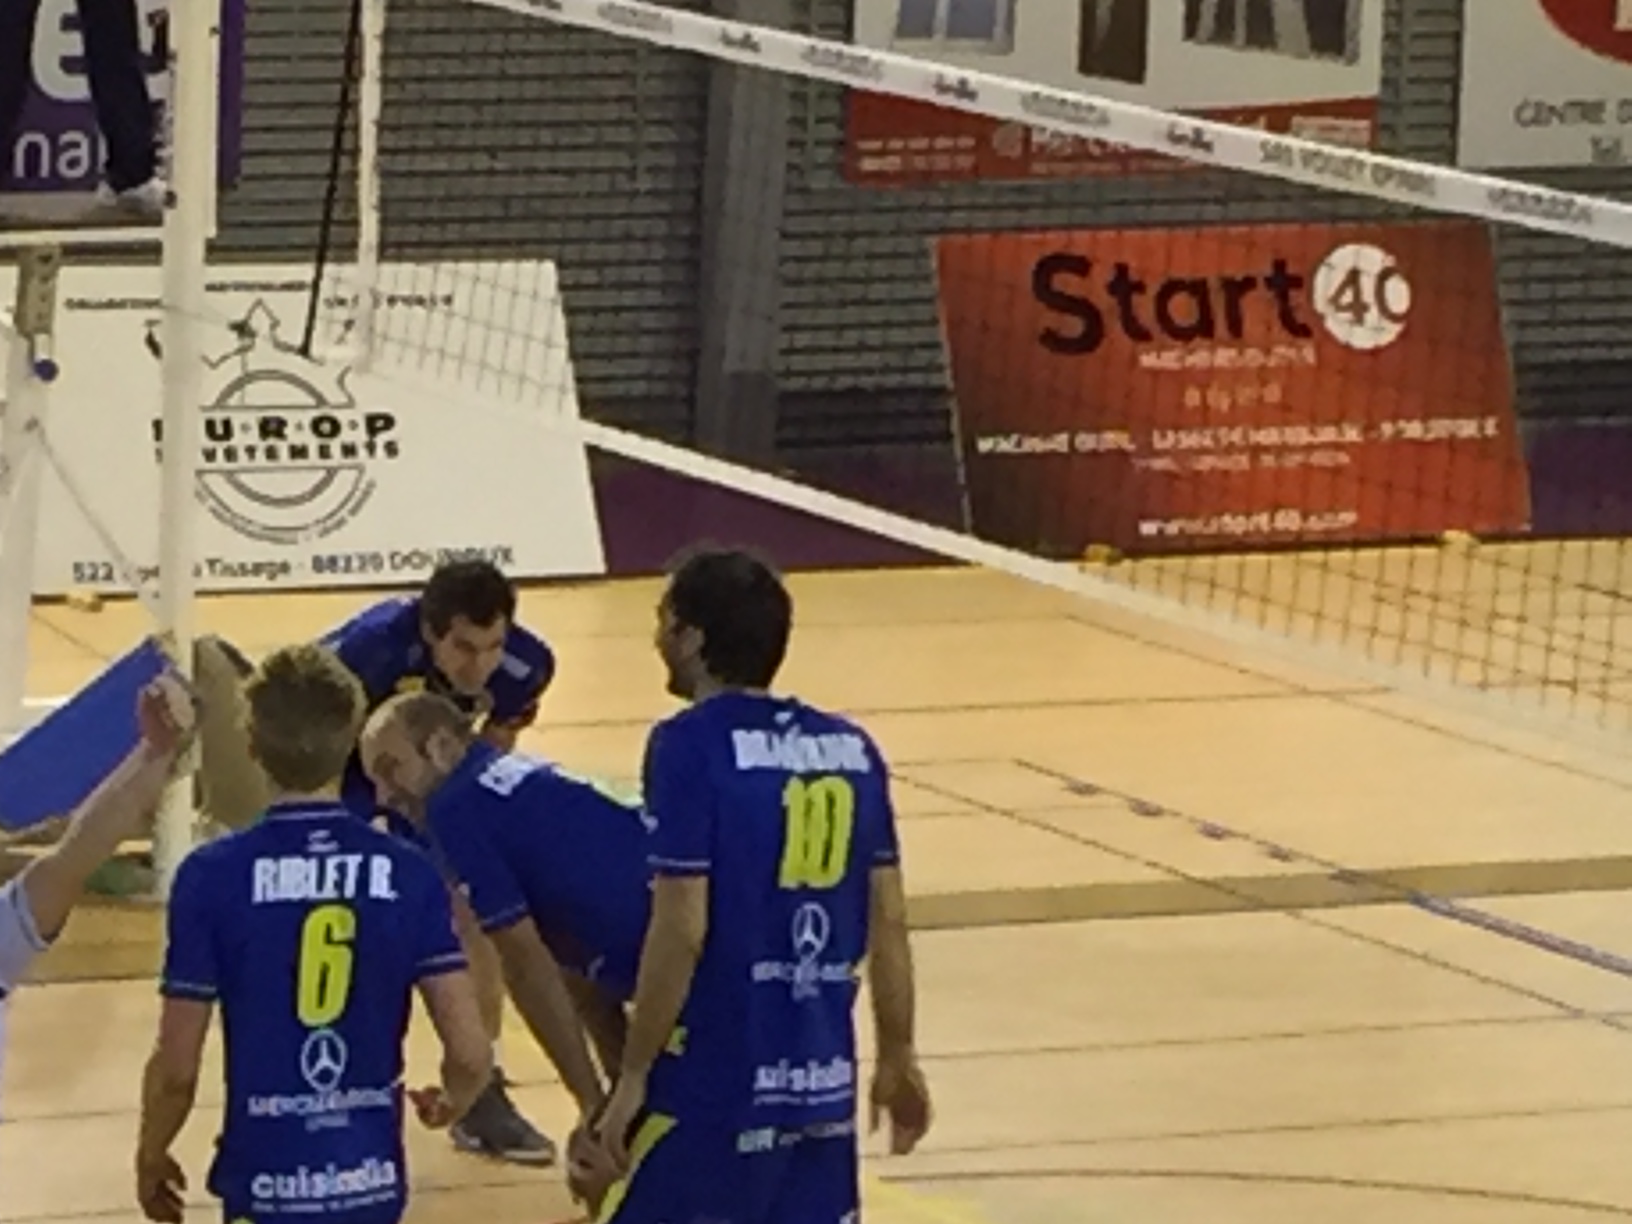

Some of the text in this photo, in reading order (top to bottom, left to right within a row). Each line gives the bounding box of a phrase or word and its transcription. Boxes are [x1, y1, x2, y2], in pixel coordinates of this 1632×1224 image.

[1028, 252, 1314, 356] Start
[779, 775, 855, 889] 10
[297, 903, 358, 1029] 6
